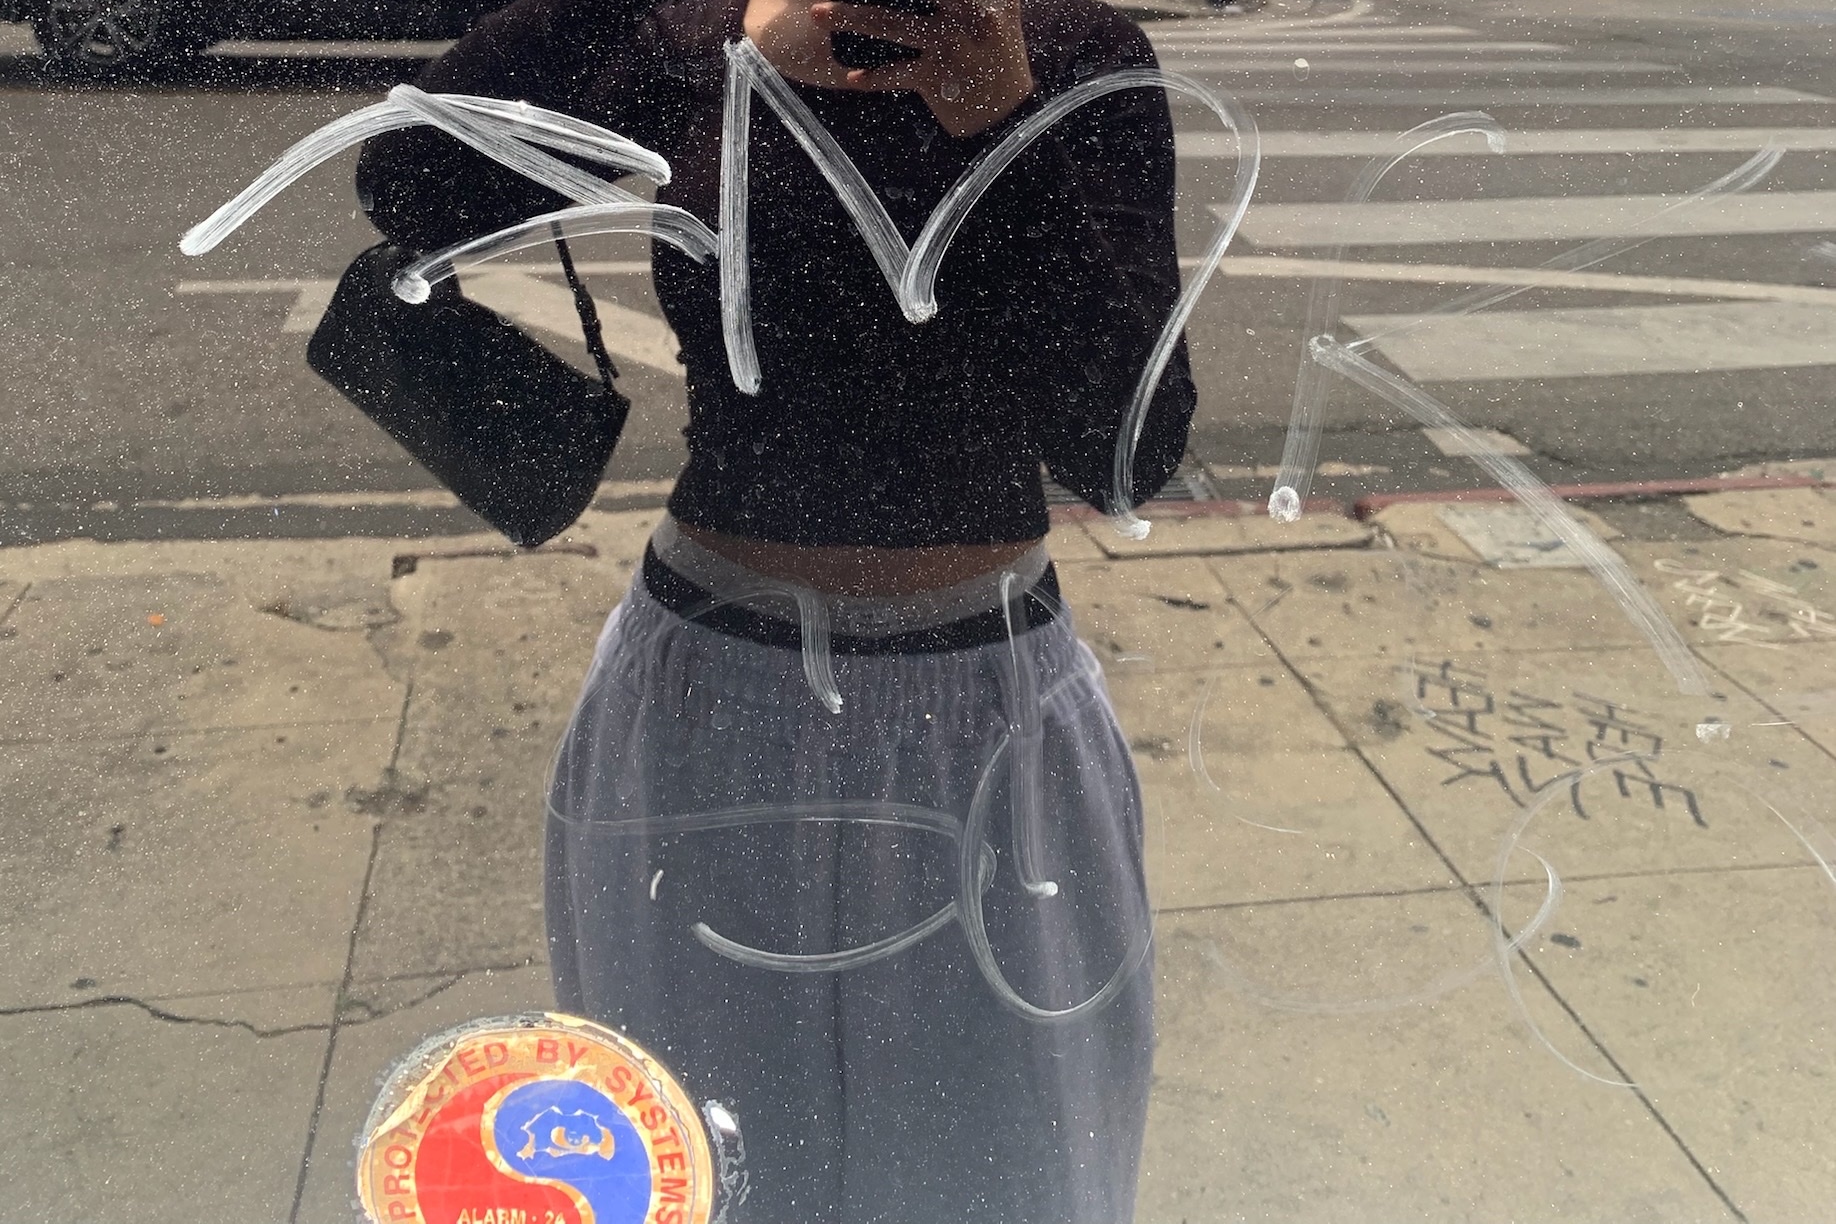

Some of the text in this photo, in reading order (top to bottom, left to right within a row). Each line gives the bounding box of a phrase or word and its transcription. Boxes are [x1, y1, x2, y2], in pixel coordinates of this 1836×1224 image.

[536, 1038, 588, 1068] BY
[605, 1065, 688, 1224] SYSTEMS
[456, 1208, 526, 1224] ALARM
